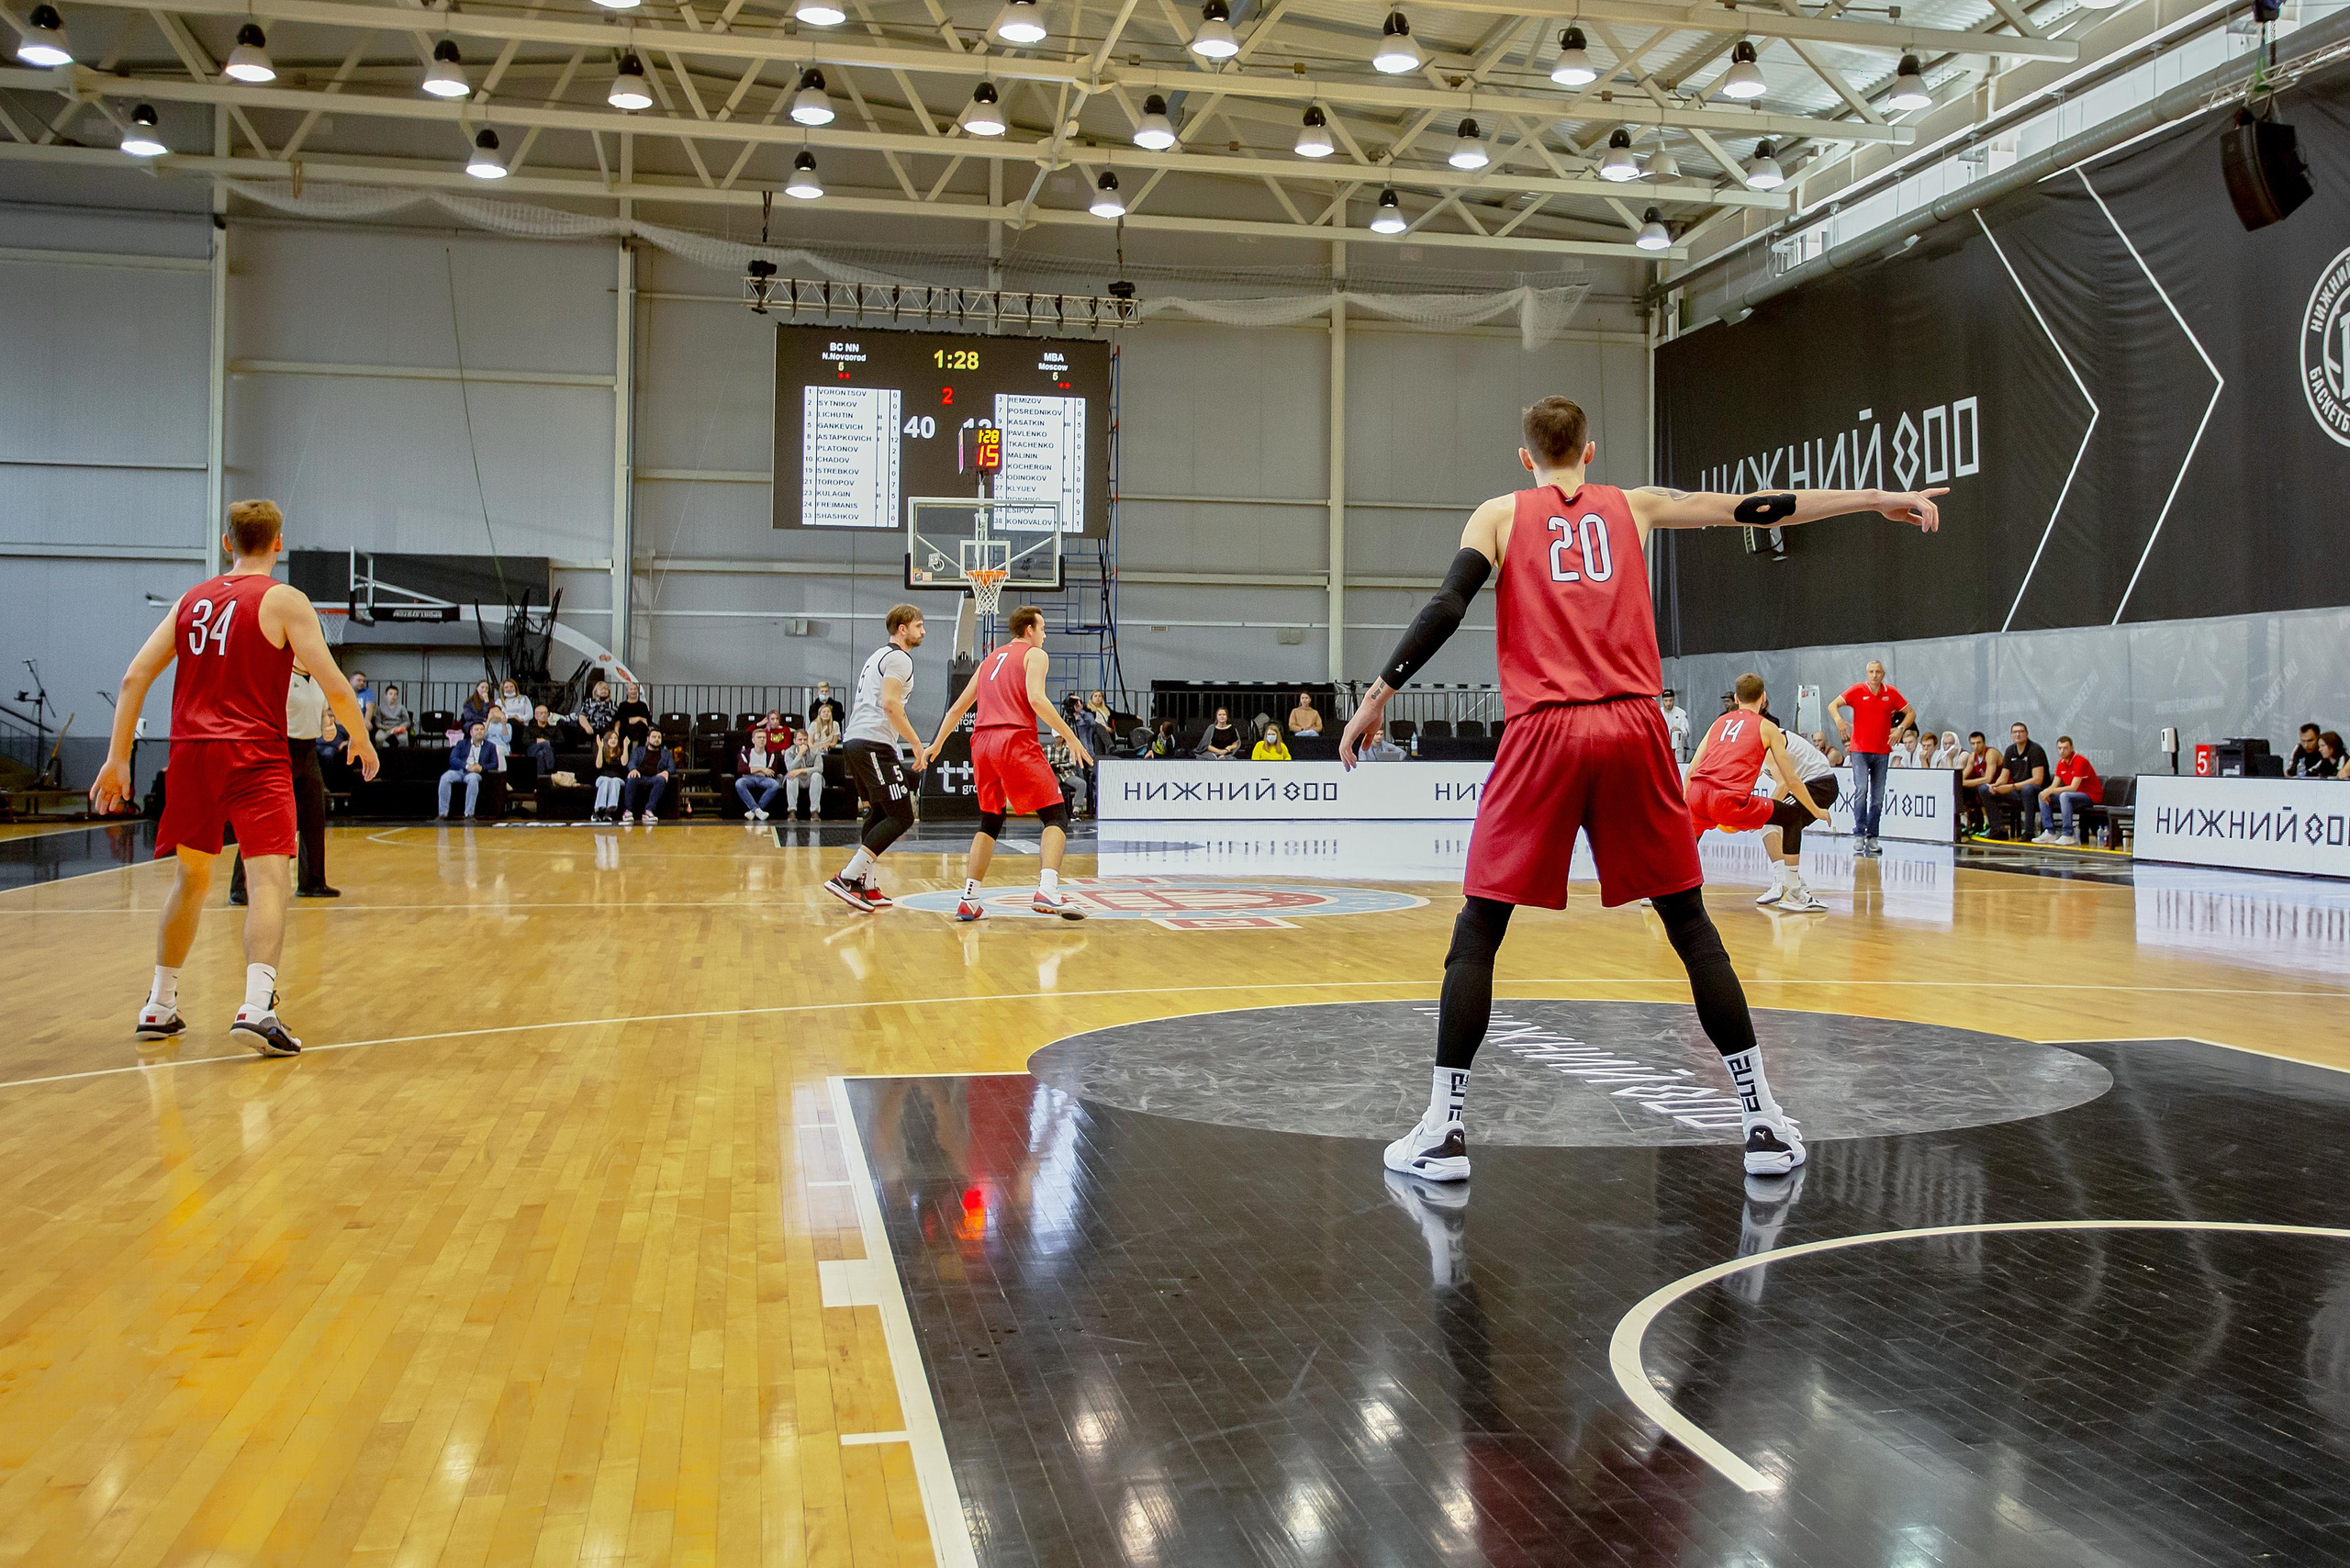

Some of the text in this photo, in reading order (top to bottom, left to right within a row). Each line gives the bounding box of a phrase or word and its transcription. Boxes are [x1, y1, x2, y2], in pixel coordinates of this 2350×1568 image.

[830, 342, 859, 353] BC NN
[1044, 352, 1065, 363] MBA
[934, 350, 979, 370] 1:28
[1038, 363, 1069, 372] Moscow
[942, 386, 954, 405] 2
[818, 433, 872, 442] ASTAPKOVICH
[903, 416, 936, 439] 40
[1892, 396, 1979, 491] 800
[978, 444, 1000, 467] 15
[1548, 513, 1613, 582] 20
[188, 599, 237, 656] 34
[990, 652, 1009, 681] 7
[1719, 719, 1745, 743] 14
[893, 765, 904, 782] 5
[2197, 751, 2208, 774] 5
[1125, 778, 1337, 801] НИЖНИЙ 800
[1901, 793, 1936, 818] 800
[2156, 806, 2350, 846] НИЖНИЙ 80
